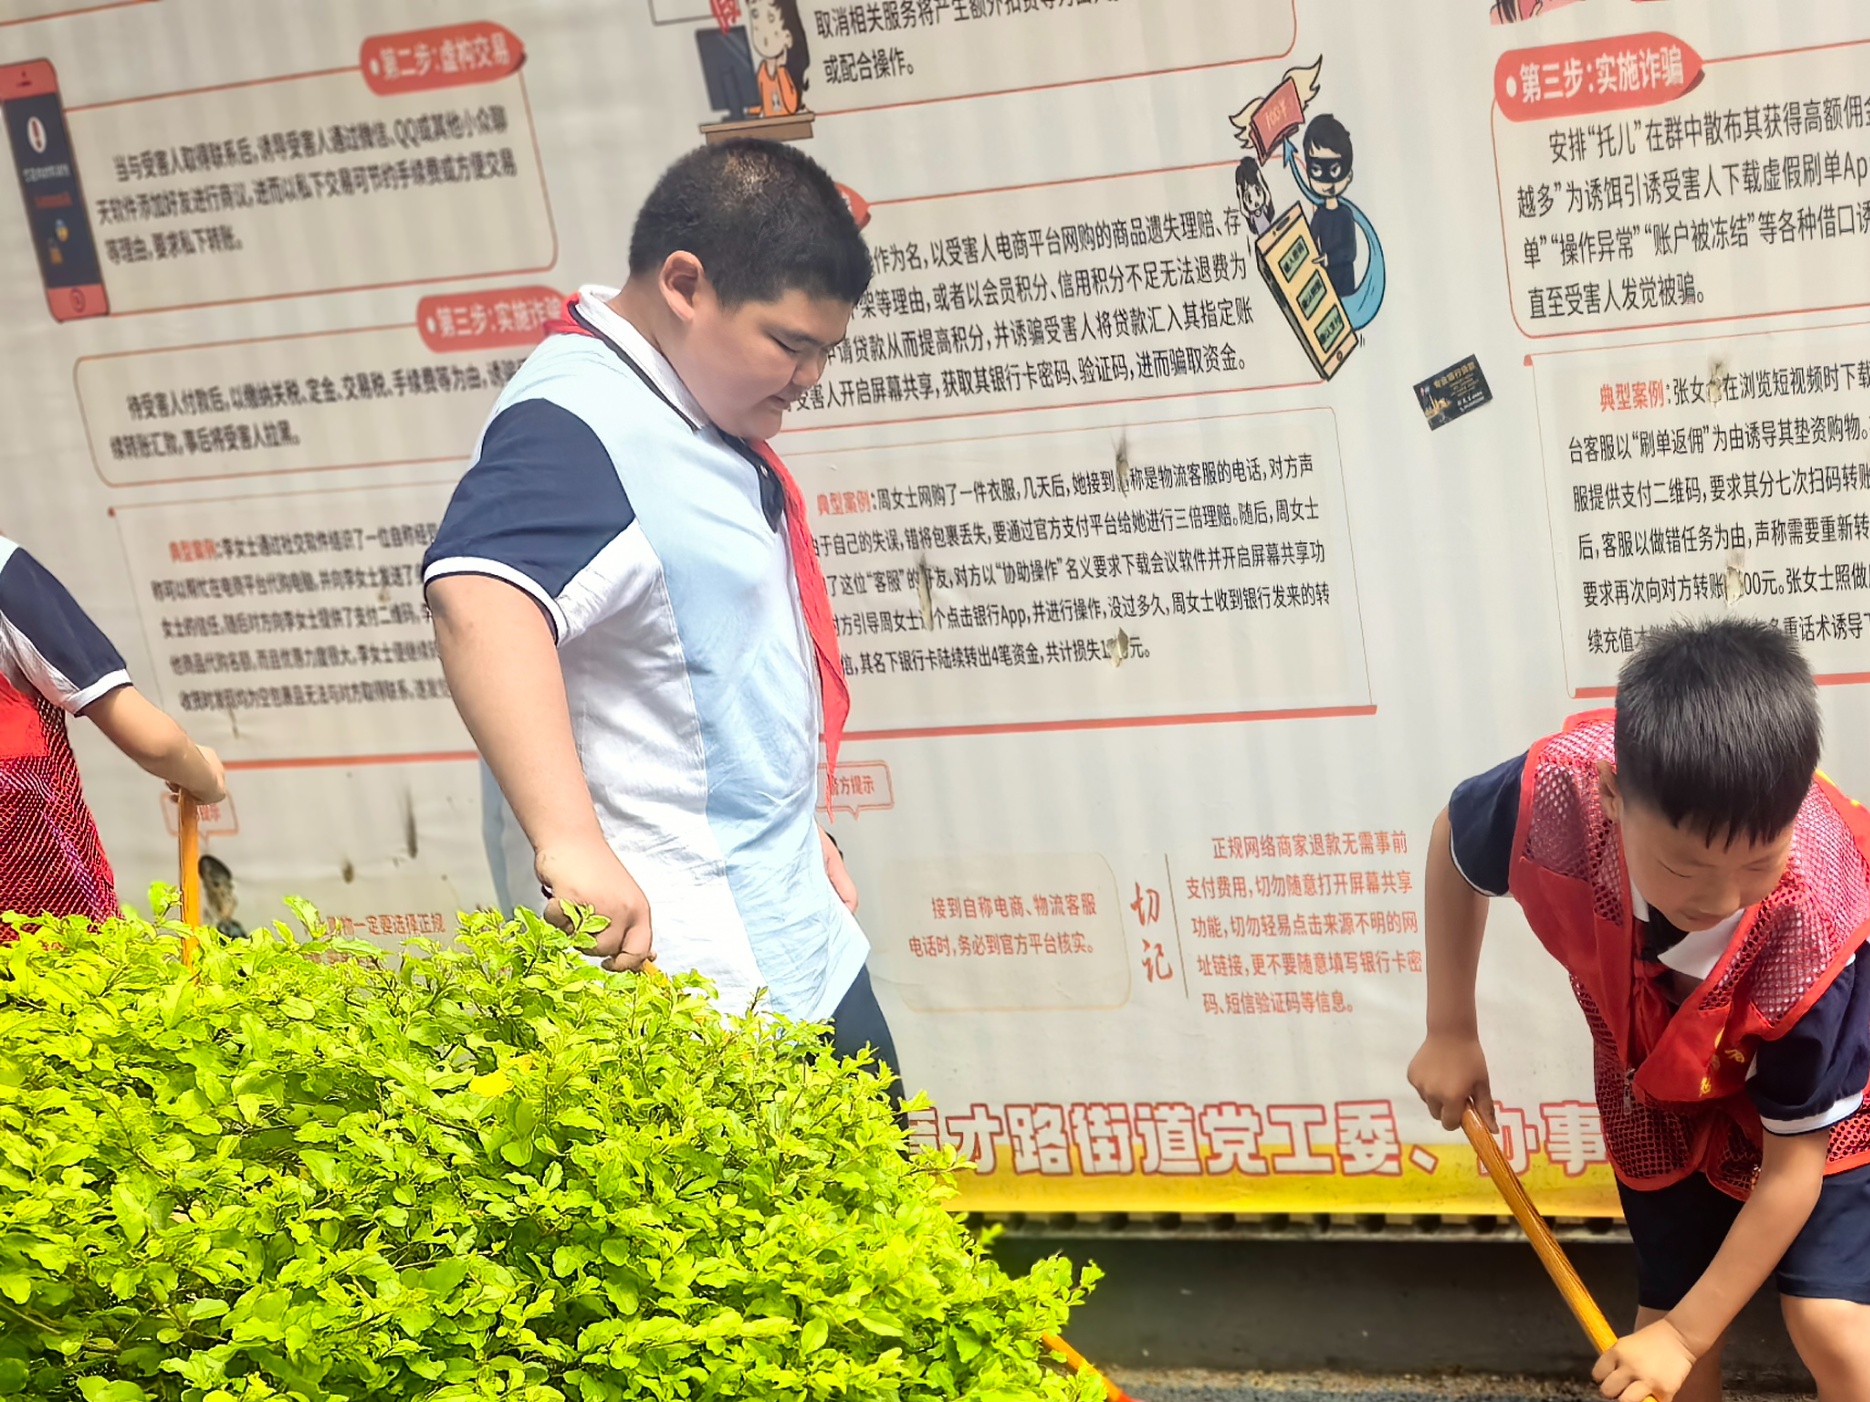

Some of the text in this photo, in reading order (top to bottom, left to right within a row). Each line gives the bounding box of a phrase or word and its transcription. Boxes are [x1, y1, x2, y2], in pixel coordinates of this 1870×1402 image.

[380, 32, 511, 81] 第二步：虚构交易
[822, 47, 915, 86] 或配合操作。
[1519, 44, 1685, 104] 第三步：实施诈骗
[1528, 271, 1704, 320] 直至受害人发觉被骗。
[787, 342, 1246, 412] 受害人开启屏幕共享，获取其银行卡密码、验证码，进而骗取资金。
[824, 539, 1326, 598] 了这位“客服”的友，对方以“协助操作”名义要求下载会议软件并开启屏幕共享功
[832, 581, 1331, 638] 方引导周女士个点击银行App，并进行操作，没过多久，周女士收到银行发来的转
[1210, 829, 1409, 860] 正规网络商家退款无需事前
[1185, 869, 1413, 899] 支付费用，切勿随意打开屏幕共享
[930, 892, 1098, 920] 接到自称电商、物流客服
[1190, 910, 1419, 939] 功能，切勿轻易点击来源不明的网
[908, 931, 1095, 958] 电话时，务必到官方平台核实。
[1130, 881, 1174, 984] 切记
[1196, 949, 1423, 978] 址链接，更不要随意填写银行卡密
[1201, 990, 1354, 1015] 码、短信验证码等信息。
